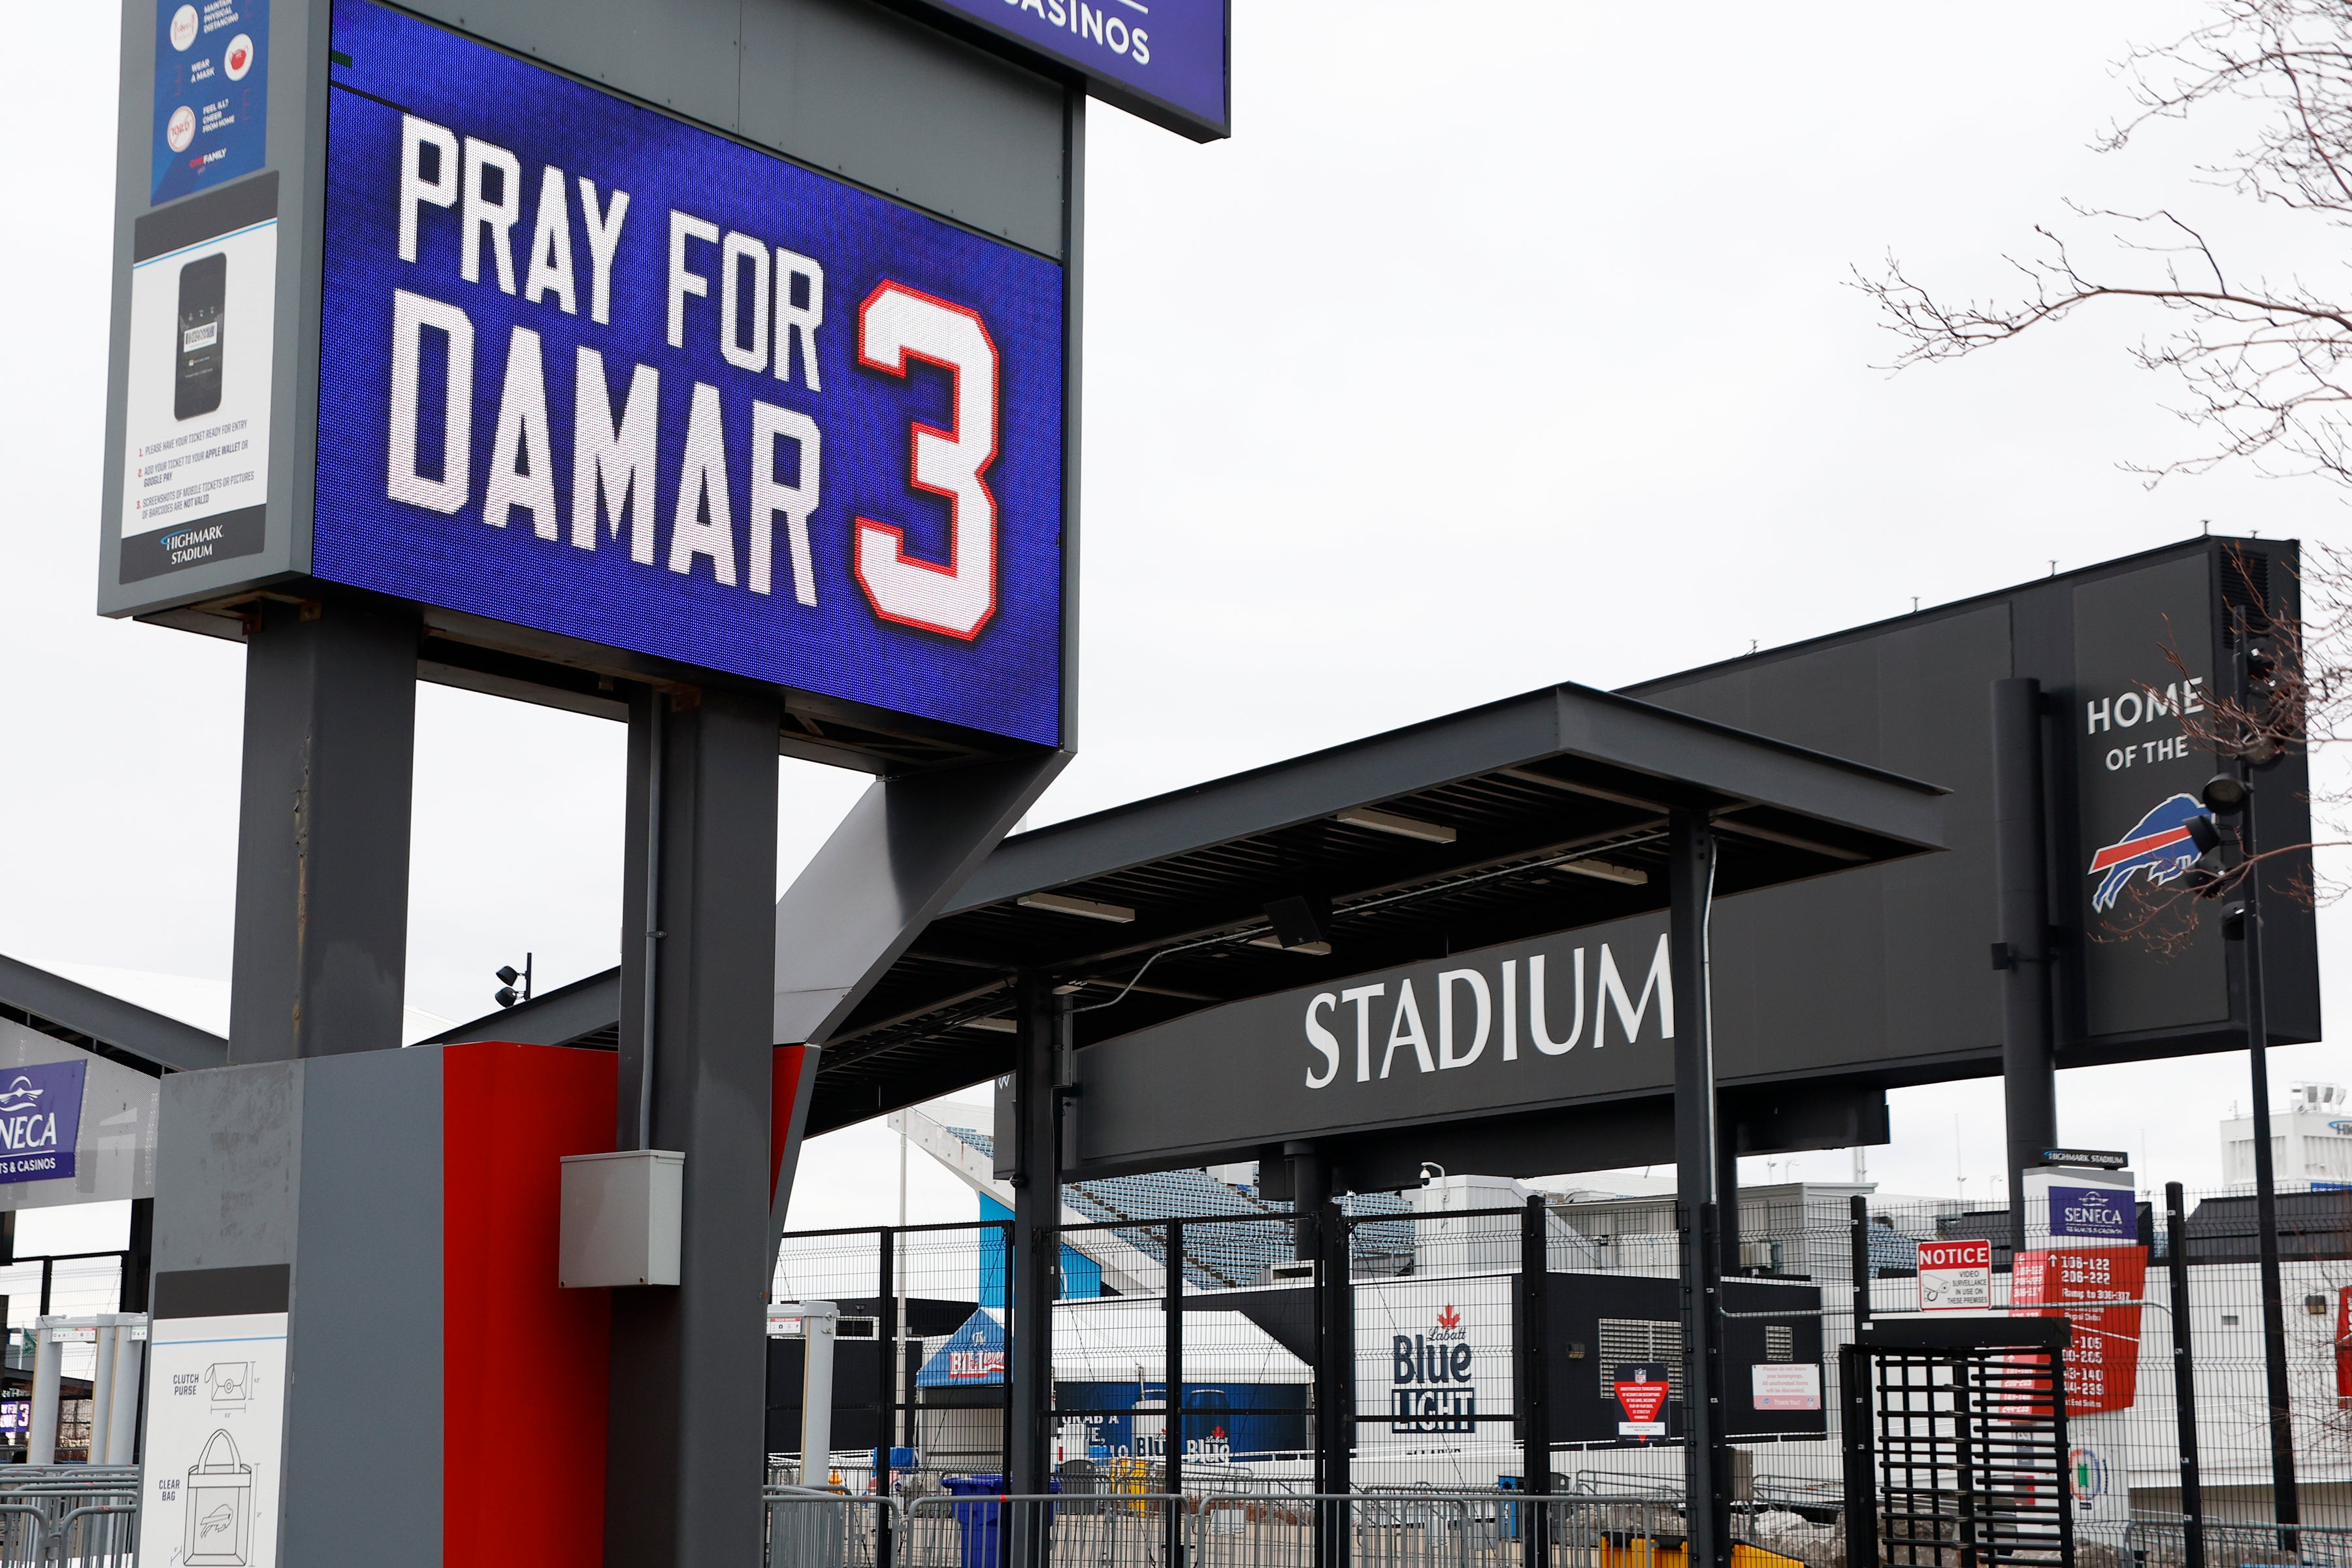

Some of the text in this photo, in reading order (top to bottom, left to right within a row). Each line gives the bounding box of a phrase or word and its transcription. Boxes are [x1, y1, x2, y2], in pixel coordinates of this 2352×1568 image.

[204, 6, 233, 25] PHYSICAL
[204, 12, 239, 34] DISTANCING
[1004, 0, 1151, 65] ASINOS
[191, 58, 210, 73] WEAR
[191, 67, 215, 84] A MASK
[203, 103, 217, 116] FEEL
[203, 110, 222, 125] CHEER
[203, 121, 219, 134] FROM
[219, 114, 235, 128] HOME
[397, 112, 825, 393] PRAY FOR
[145, 442, 162, 455] PLEASE
[163, 438, 174, 451] HAVE
[175, 435, 188, 447] YOUR
[188, 431, 205, 444] TICKET
[205, 427, 221, 439] READY
[221, 424, 232, 434] FOR
[232, 419, 248, 433] ENTRY
[144, 466, 154, 476] ADD
[155, 461, 167, 473] YOUR
[167, 456, 184, 470] TICKET
[185, 455, 191, 465] TO
[191, 451, 204, 463] YOUR
[205, 446, 221, 459] APPLE
[221, 441, 241, 455] WALLET
[241, 439, 249, 449] OR
[387, 278, 1000, 642] DAMAR 3
[142, 491, 176, 508] SCREENSHOTS
[176, 489, 182, 499] OF
[183, 484, 202, 497] MOBILE
[202, 478, 222, 493] TICKETS
[223, 477, 230, 487] OR
[230, 470, 255, 485] PICTURES
[144, 471, 173, 488] GOOGLE PAY
[142, 493, 210, 519] OF BARCODES ARE NOT VALID
[166, 525, 223, 551] HIGHMARK
[171, 543, 213, 565] STADIUM
[2087, 676, 2205, 735] HOME
[2105, 734, 2189, 772] OF THE
[1305, 932, 1673, 1090] STADIUM
[10, 1161, 16, 1173] &
[17, 1157, 56, 1173] CASINOS
[2048, 1152, 2124, 1164] HIGHMARK STADIUM
[2064, 1207, 2123, 1225] SENECA
[1919, 1247, 1989, 1266] NOTICE
[2061, 1255, 2111, 1271] 106-122
[1952, 1279, 1987, 1287] SURVEILLANCE
[2061, 1270, 2111, 1285] 206-222
[2086, 1289, 2096, 1299] to
[1426, 1326, 1467, 1341] Labatt
[1392, 1334, 1473, 1384] Blue
[2061, 1348, 2103, 1364] 00-205
[173, 1373, 199, 1384] CLUTCH
[174, 1385, 197, 1396] PURSE
[18, 1403, 29, 1427] 3
[1392, 1390, 1473, 1431] LIGHT
[159, 1479, 180, 1490] CLEAR
[162, 1491, 176, 1501] BAG
